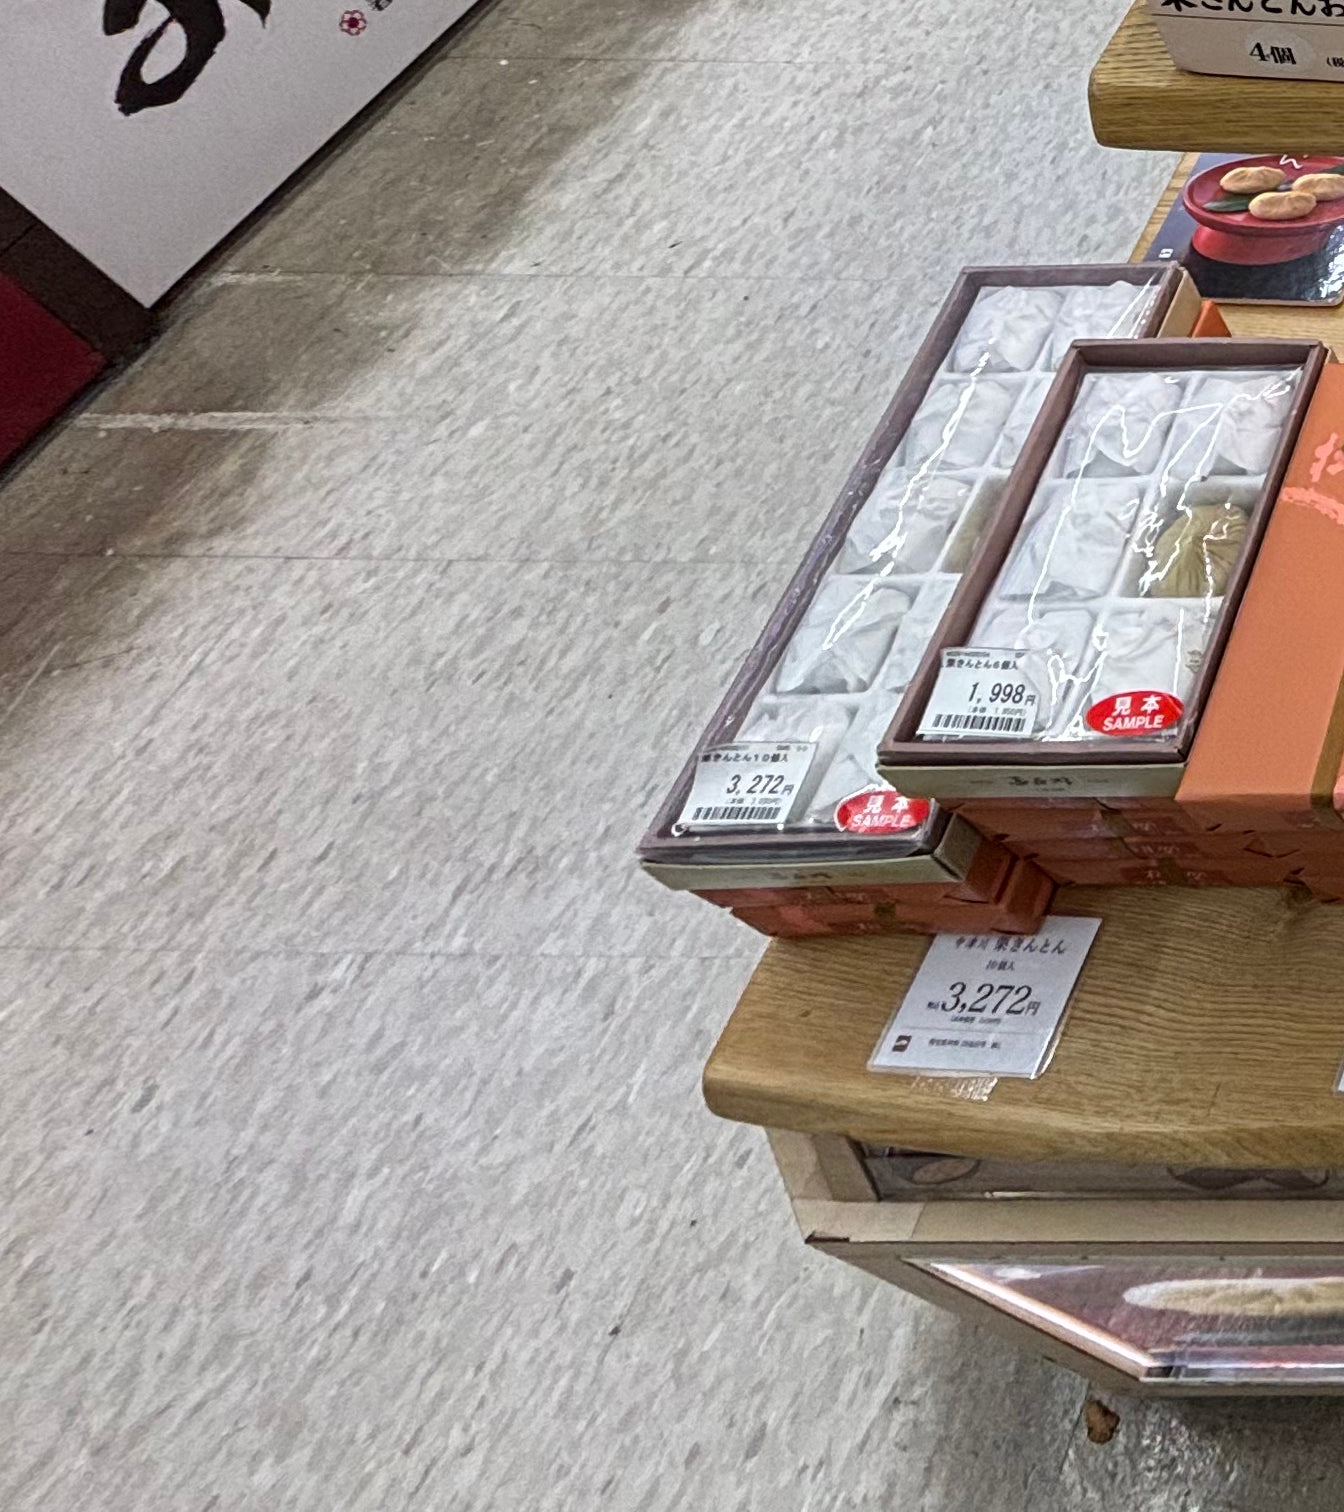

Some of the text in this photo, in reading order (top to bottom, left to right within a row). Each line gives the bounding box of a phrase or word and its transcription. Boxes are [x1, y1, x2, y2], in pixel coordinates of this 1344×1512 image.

[1248, 41, 1297, 66] 4個
[968, 681, 1037, 706] 1,998円
[1114, 695, 1163, 717] 見本
[1103, 714, 1166, 731] SAMPLE
[725, 773, 796, 797] 3,272円
[863, 794, 911, 815] 見本
[851, 813, 916, 829] SAMPLE
[939, 980, 1042, 1017] 3,272円
